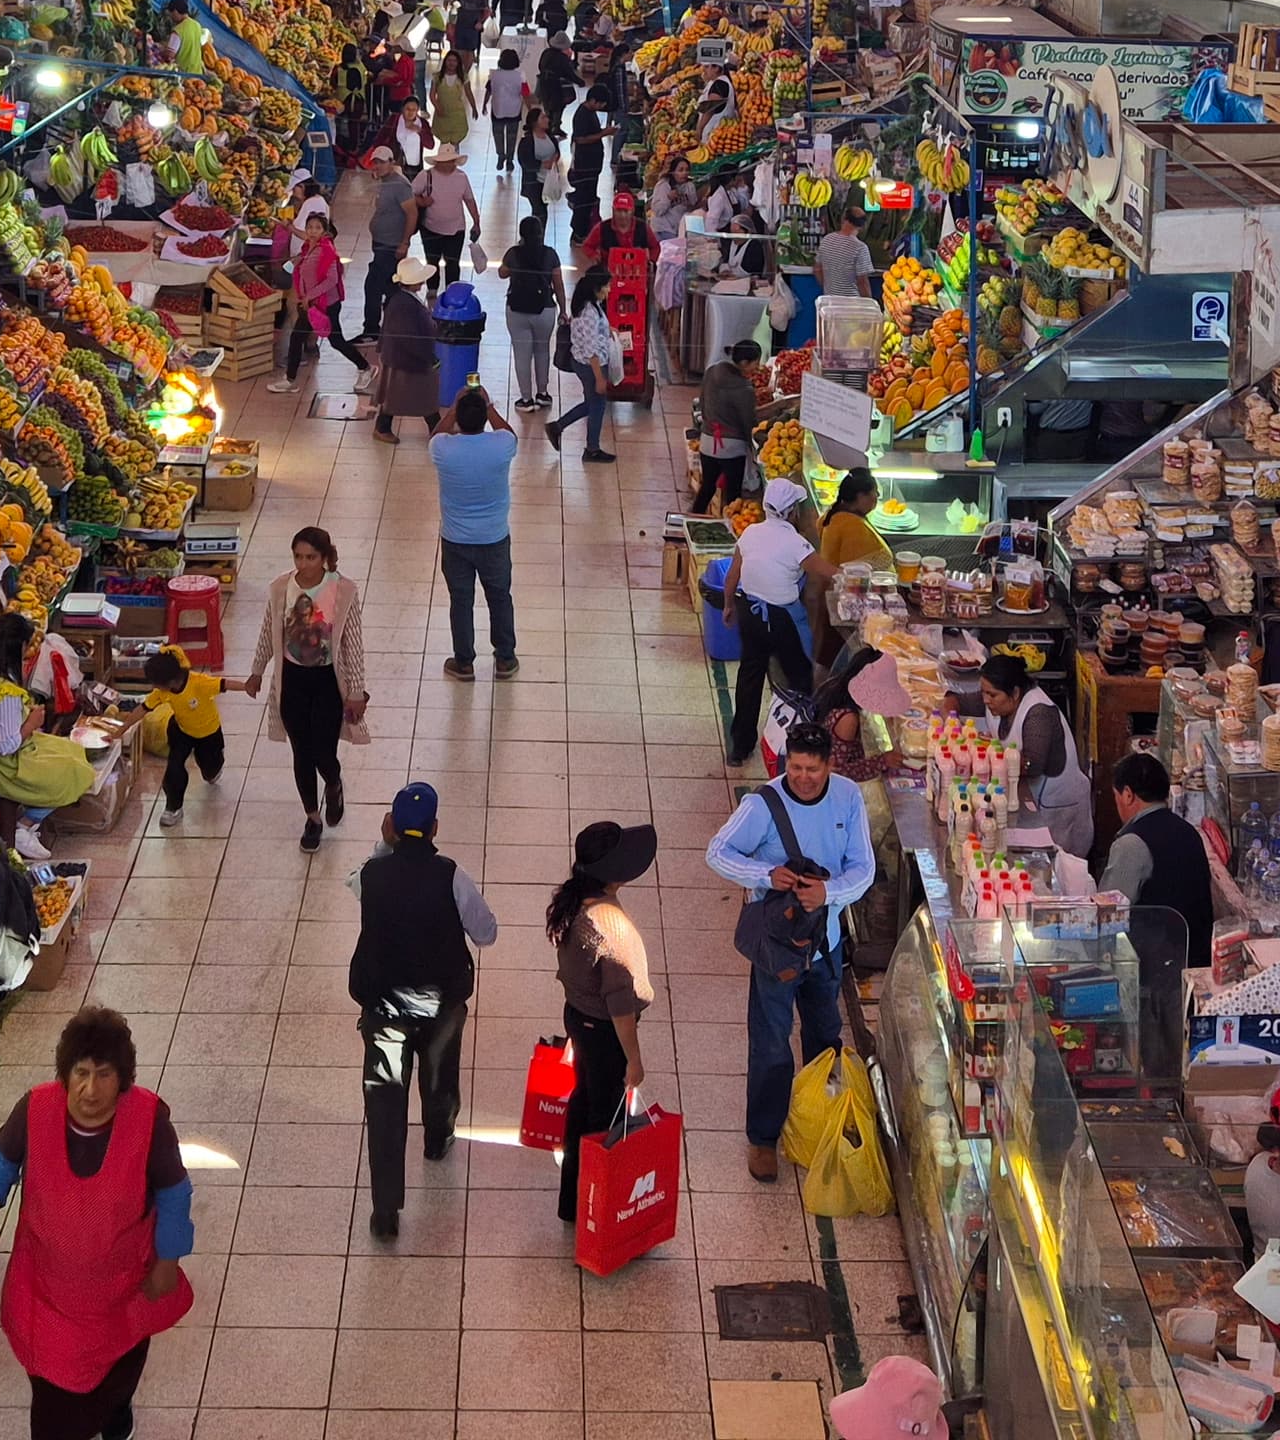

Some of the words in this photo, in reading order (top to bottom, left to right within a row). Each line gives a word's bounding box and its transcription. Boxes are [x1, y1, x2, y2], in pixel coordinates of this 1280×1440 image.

[1032, 43, 1107, 65] Productos
[1118, 68, 1188, 85] derivados
[538, 1100, 567, 1115] New
[616, 1205, 635, 1224] New
[636, 1190, 666, 1213] Athletic
